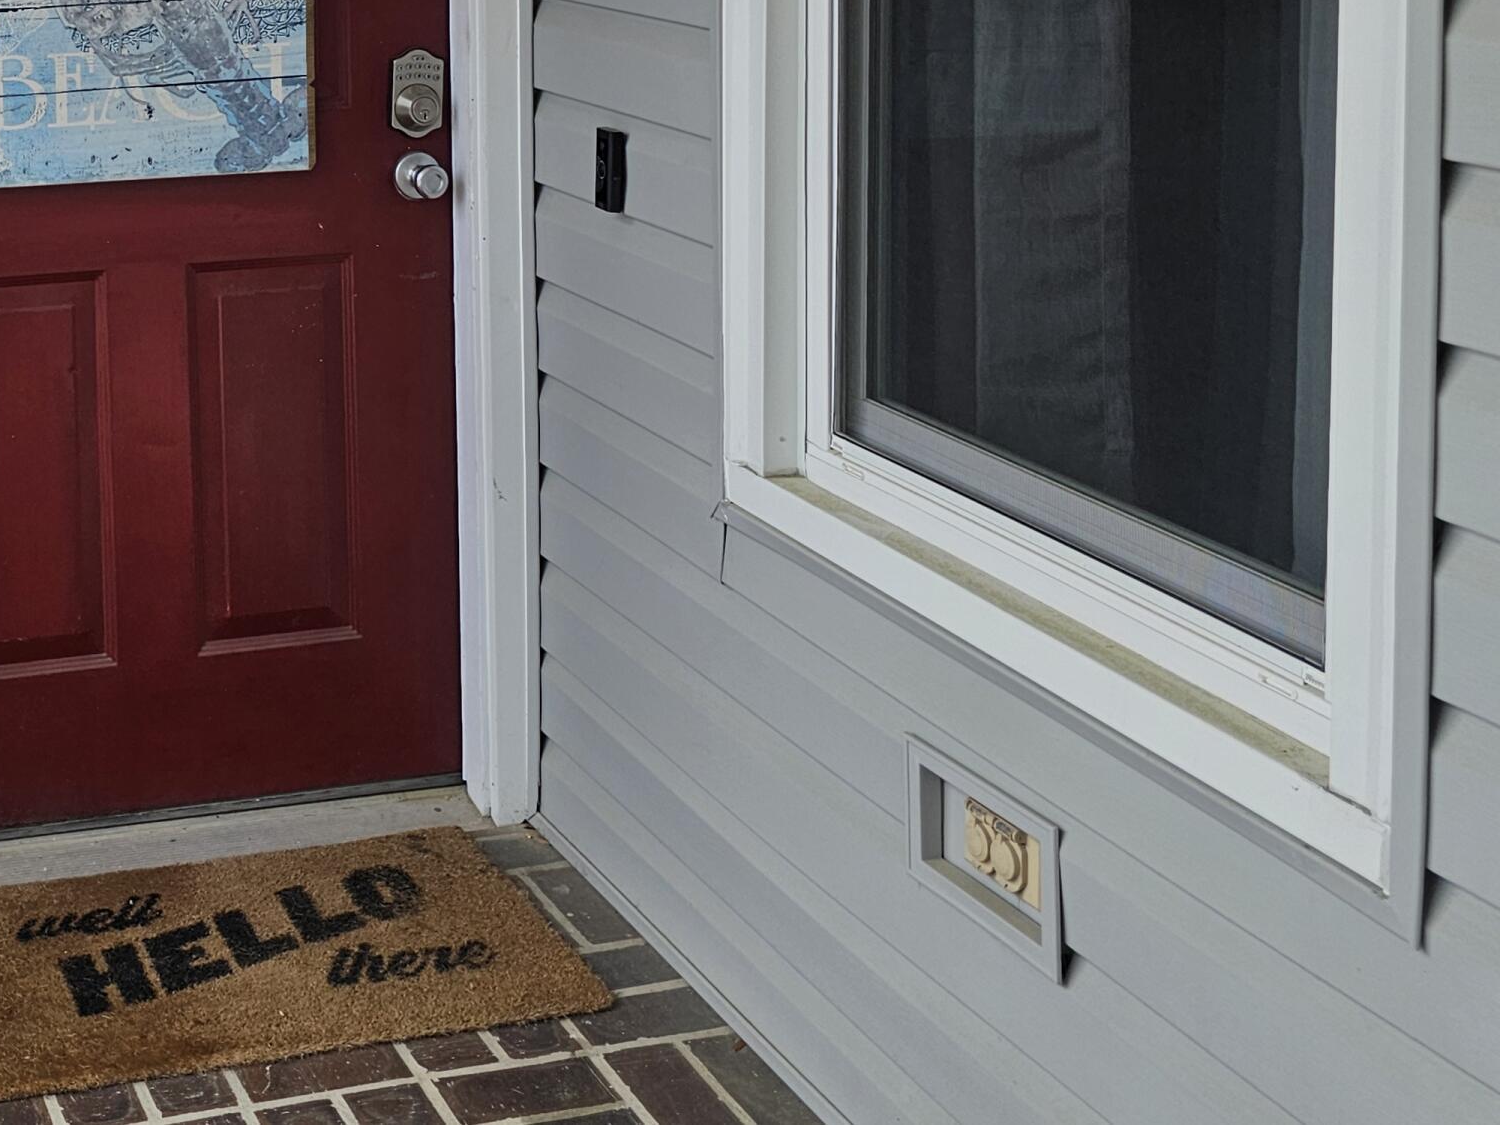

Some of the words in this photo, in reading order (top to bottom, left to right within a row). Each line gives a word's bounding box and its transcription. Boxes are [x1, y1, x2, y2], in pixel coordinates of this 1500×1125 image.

[15, 892, 163, 943] well
[57, 863, 423, 1018] HELLO
[327, 941, 499, 987] there
